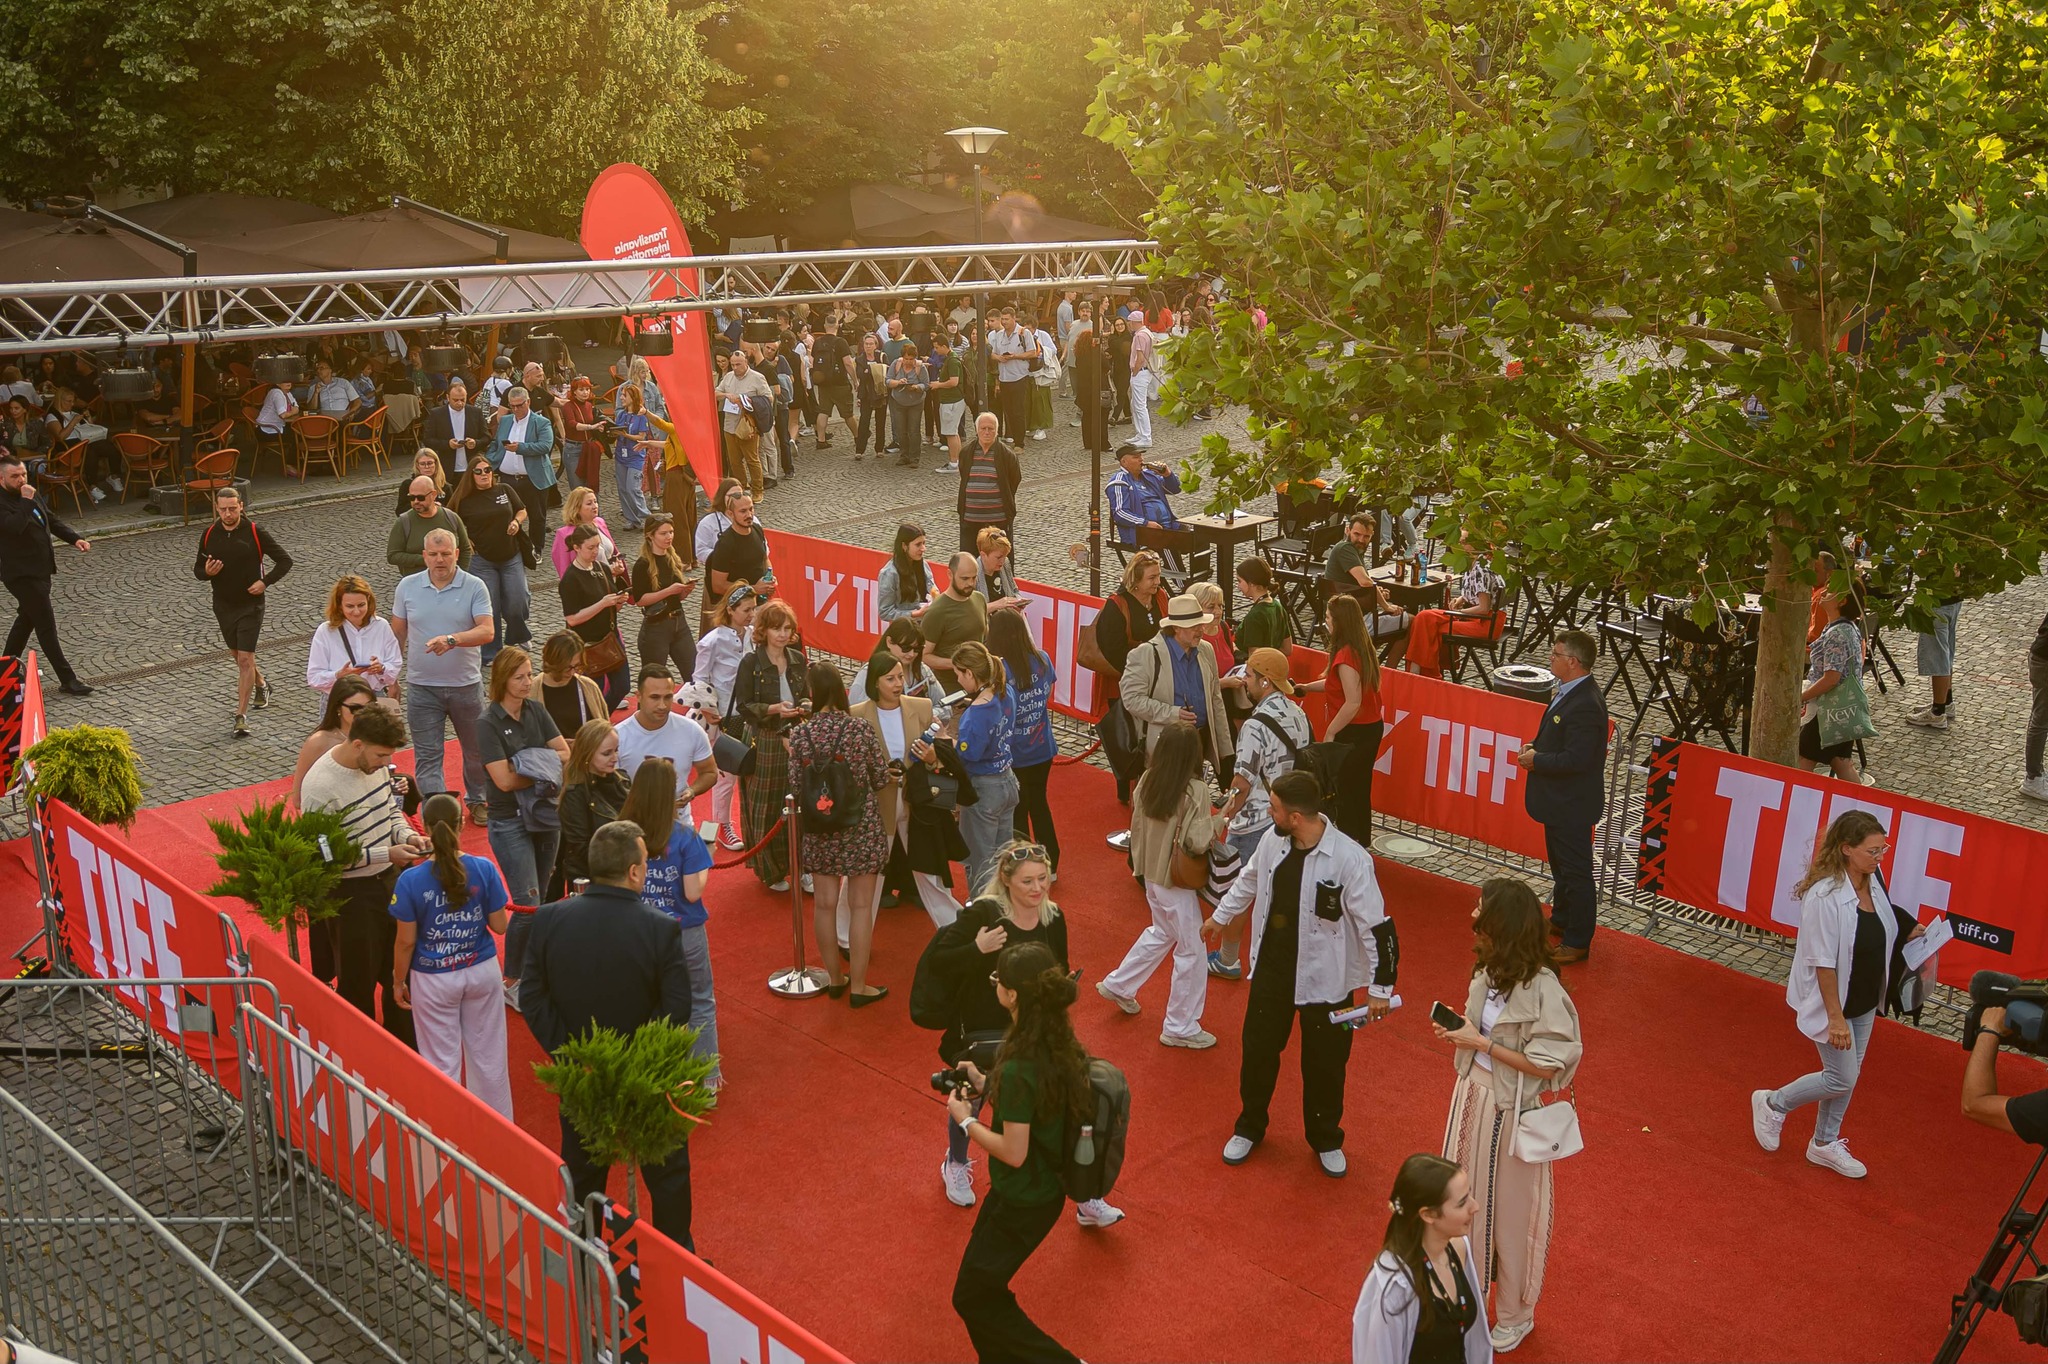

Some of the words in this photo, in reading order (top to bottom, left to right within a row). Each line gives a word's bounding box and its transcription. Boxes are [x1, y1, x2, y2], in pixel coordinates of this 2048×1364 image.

[1421, 715, 1522, 805] TIFF
[641, 897, 665, 908] ATCH
[434, 910, 473, 925] CAMERA
[67, 825, 184, 1035] TIFF
[1957, 921, 2000, 945] tiff.ro
